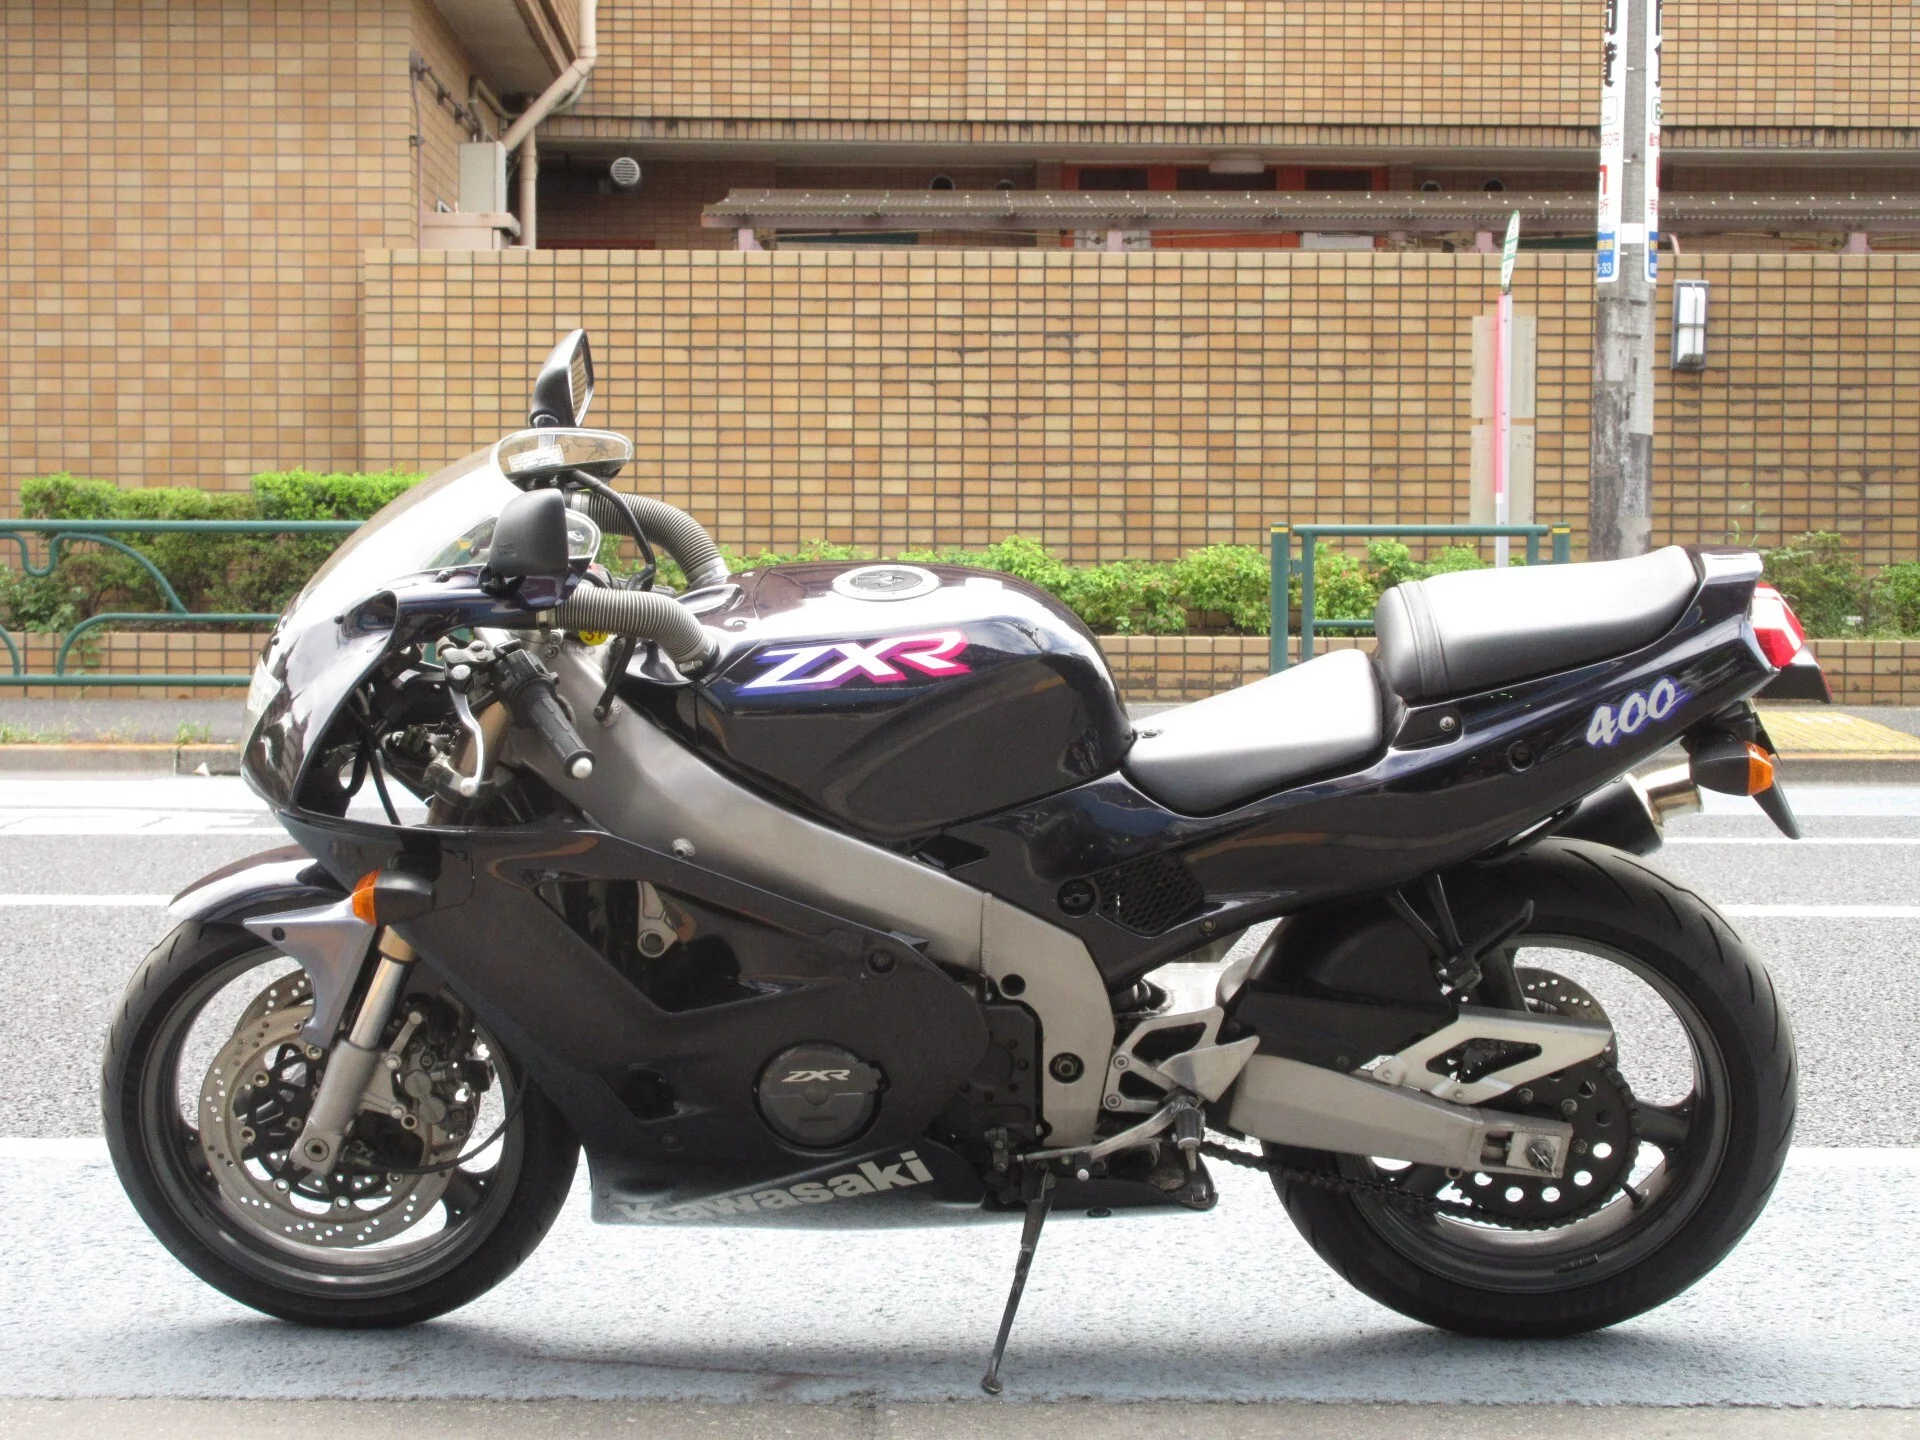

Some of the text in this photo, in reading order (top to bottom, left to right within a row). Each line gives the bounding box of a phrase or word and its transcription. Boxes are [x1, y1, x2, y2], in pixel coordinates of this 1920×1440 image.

[735, 628, 973, 697] ZXR
[1586, 677, 1685, 746] 400
[781, 1069, 851, 1083] ZXR
[612, 1150, 935, 1223] Kawasaki
